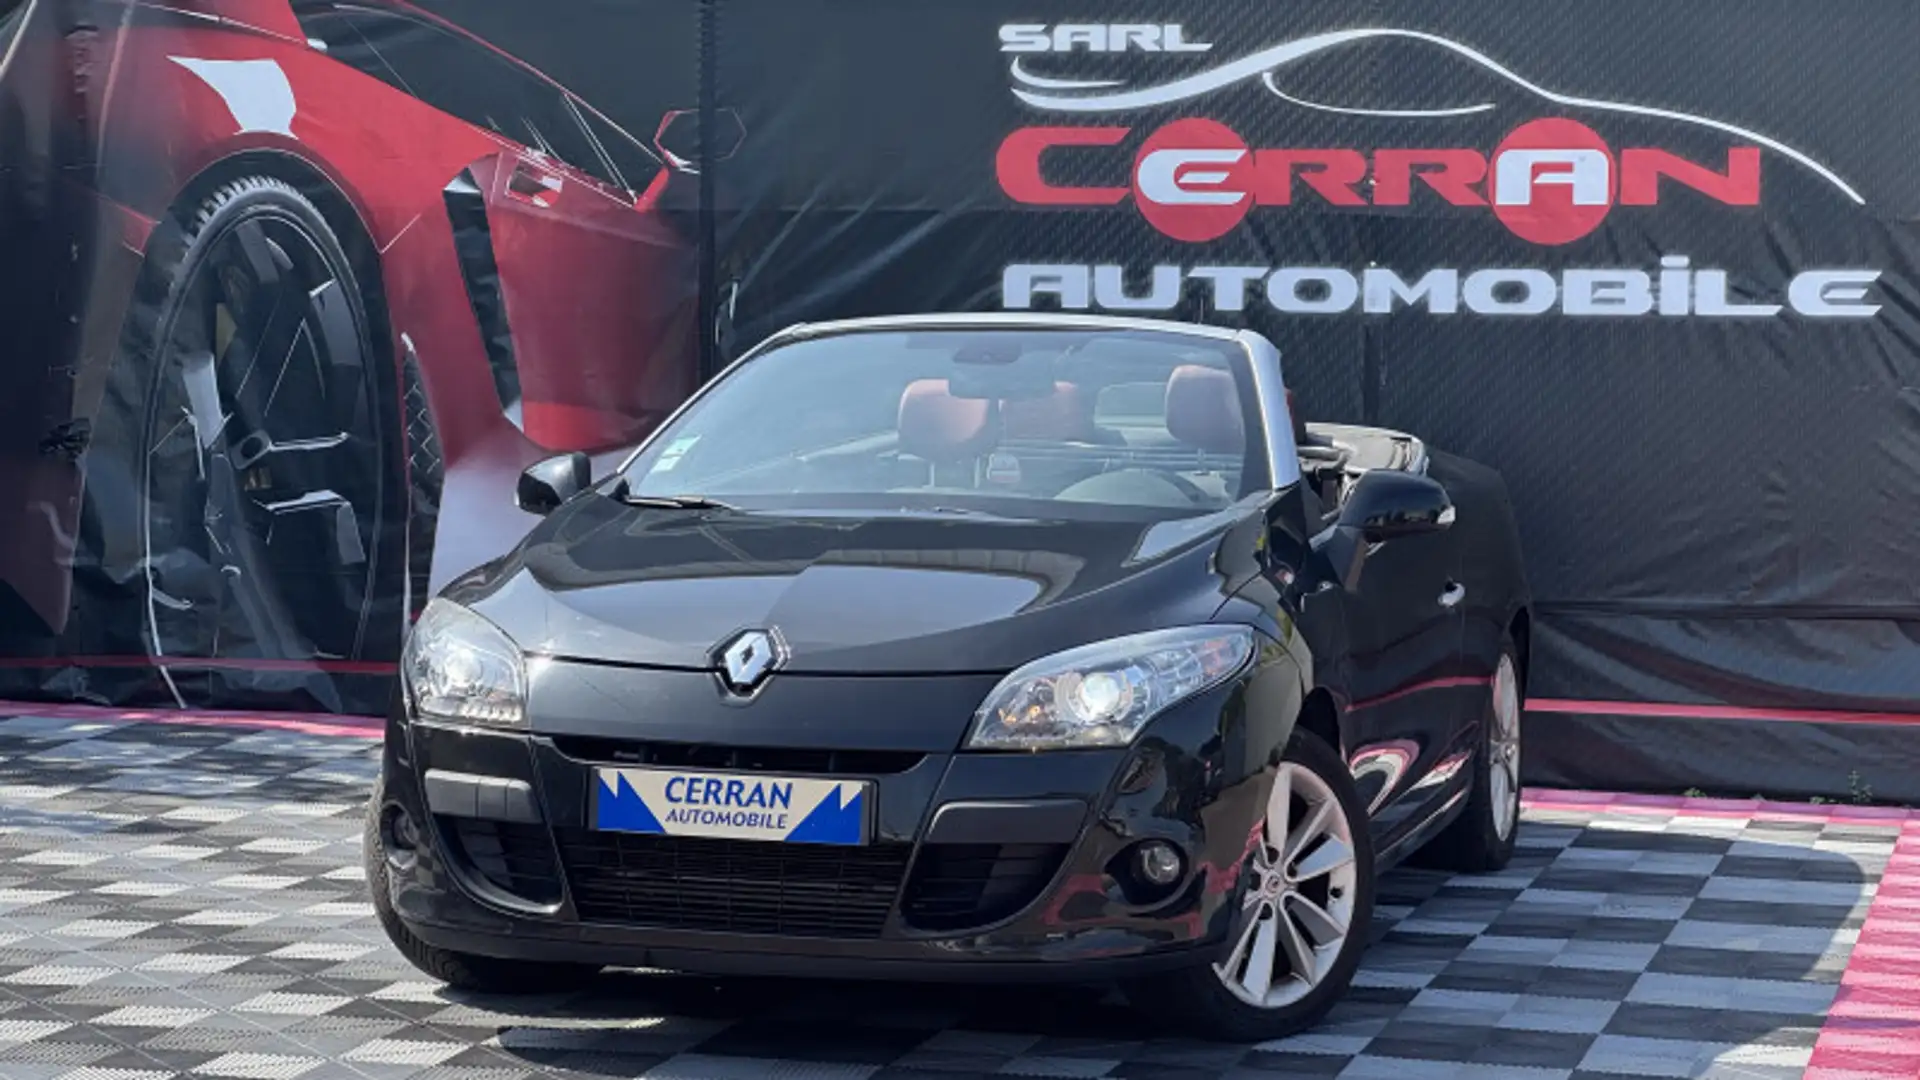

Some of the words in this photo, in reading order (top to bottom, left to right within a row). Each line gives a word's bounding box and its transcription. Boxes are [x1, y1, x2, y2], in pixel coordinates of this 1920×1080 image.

[999, 23, 1213, 52] SARL
[996, 126, 1761, 206] CERRAN
[665, 776, 793, 809] CERRAN
[665, 808, 788, 830] AUTOMOBILE
